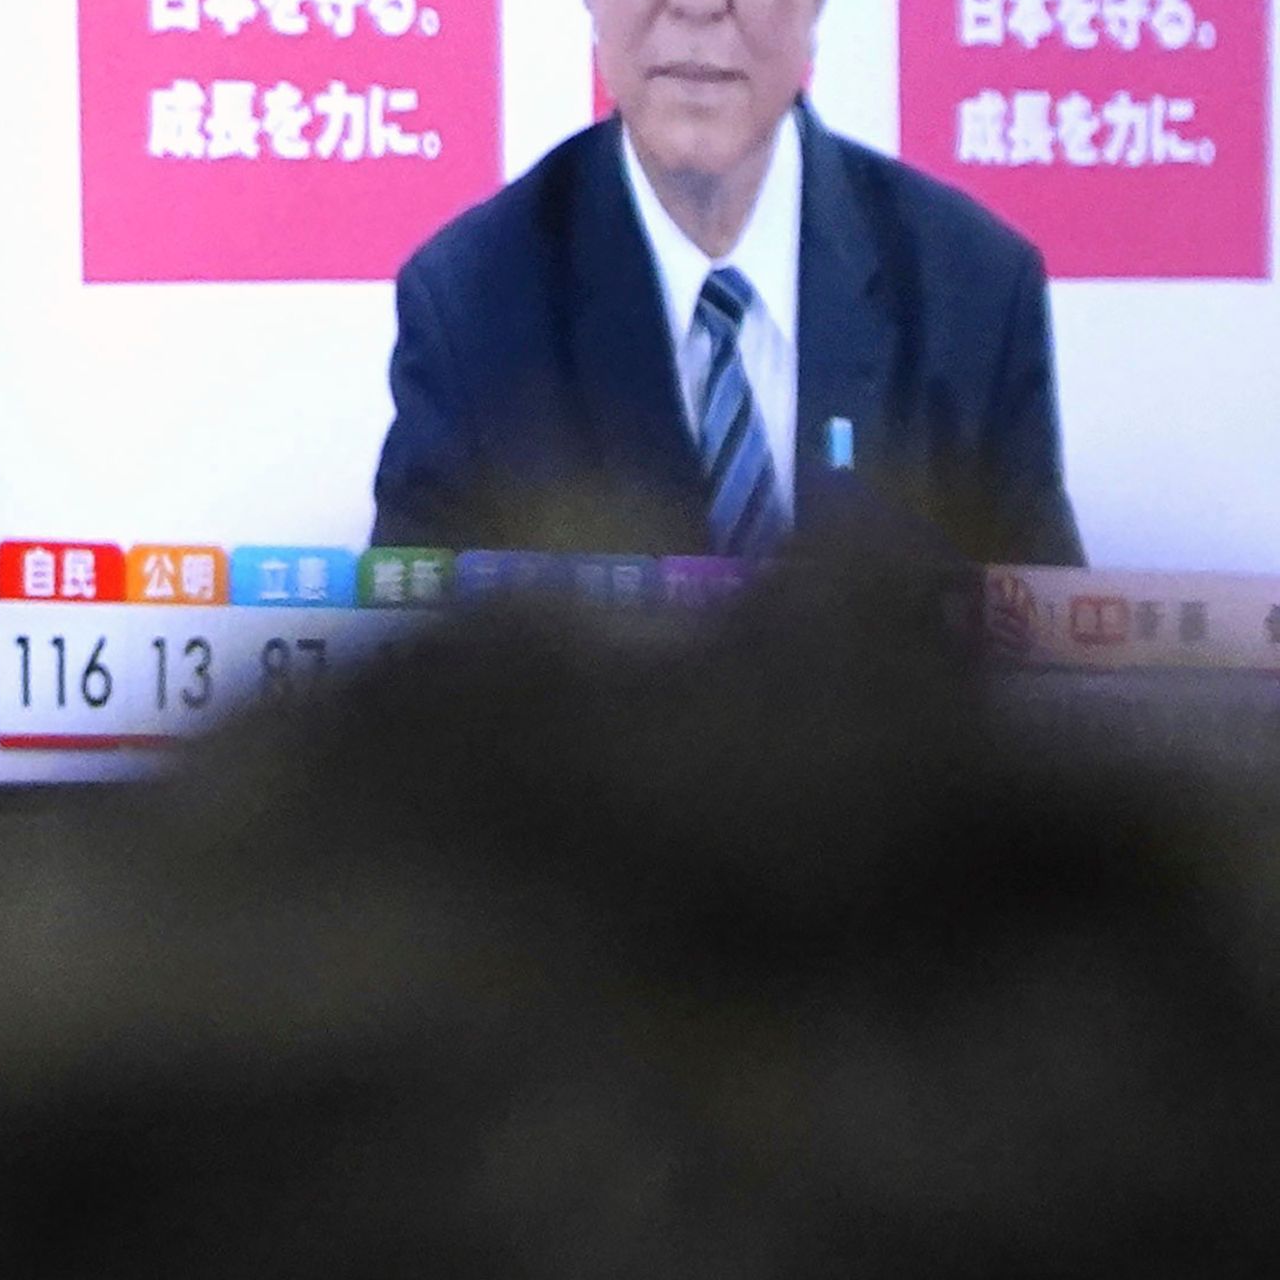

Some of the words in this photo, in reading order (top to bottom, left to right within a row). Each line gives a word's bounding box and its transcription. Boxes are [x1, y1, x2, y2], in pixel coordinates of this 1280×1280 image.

[147, 79, 441, 161] 成長を力に。
[955, 88, 1216, 166] 成長を力に。
[22, 548, 97, 599] 自民
[143, 553, 215, 600] 公明
[15, 635, 113, 710] 116
[151, 637, 213, 709] 13
